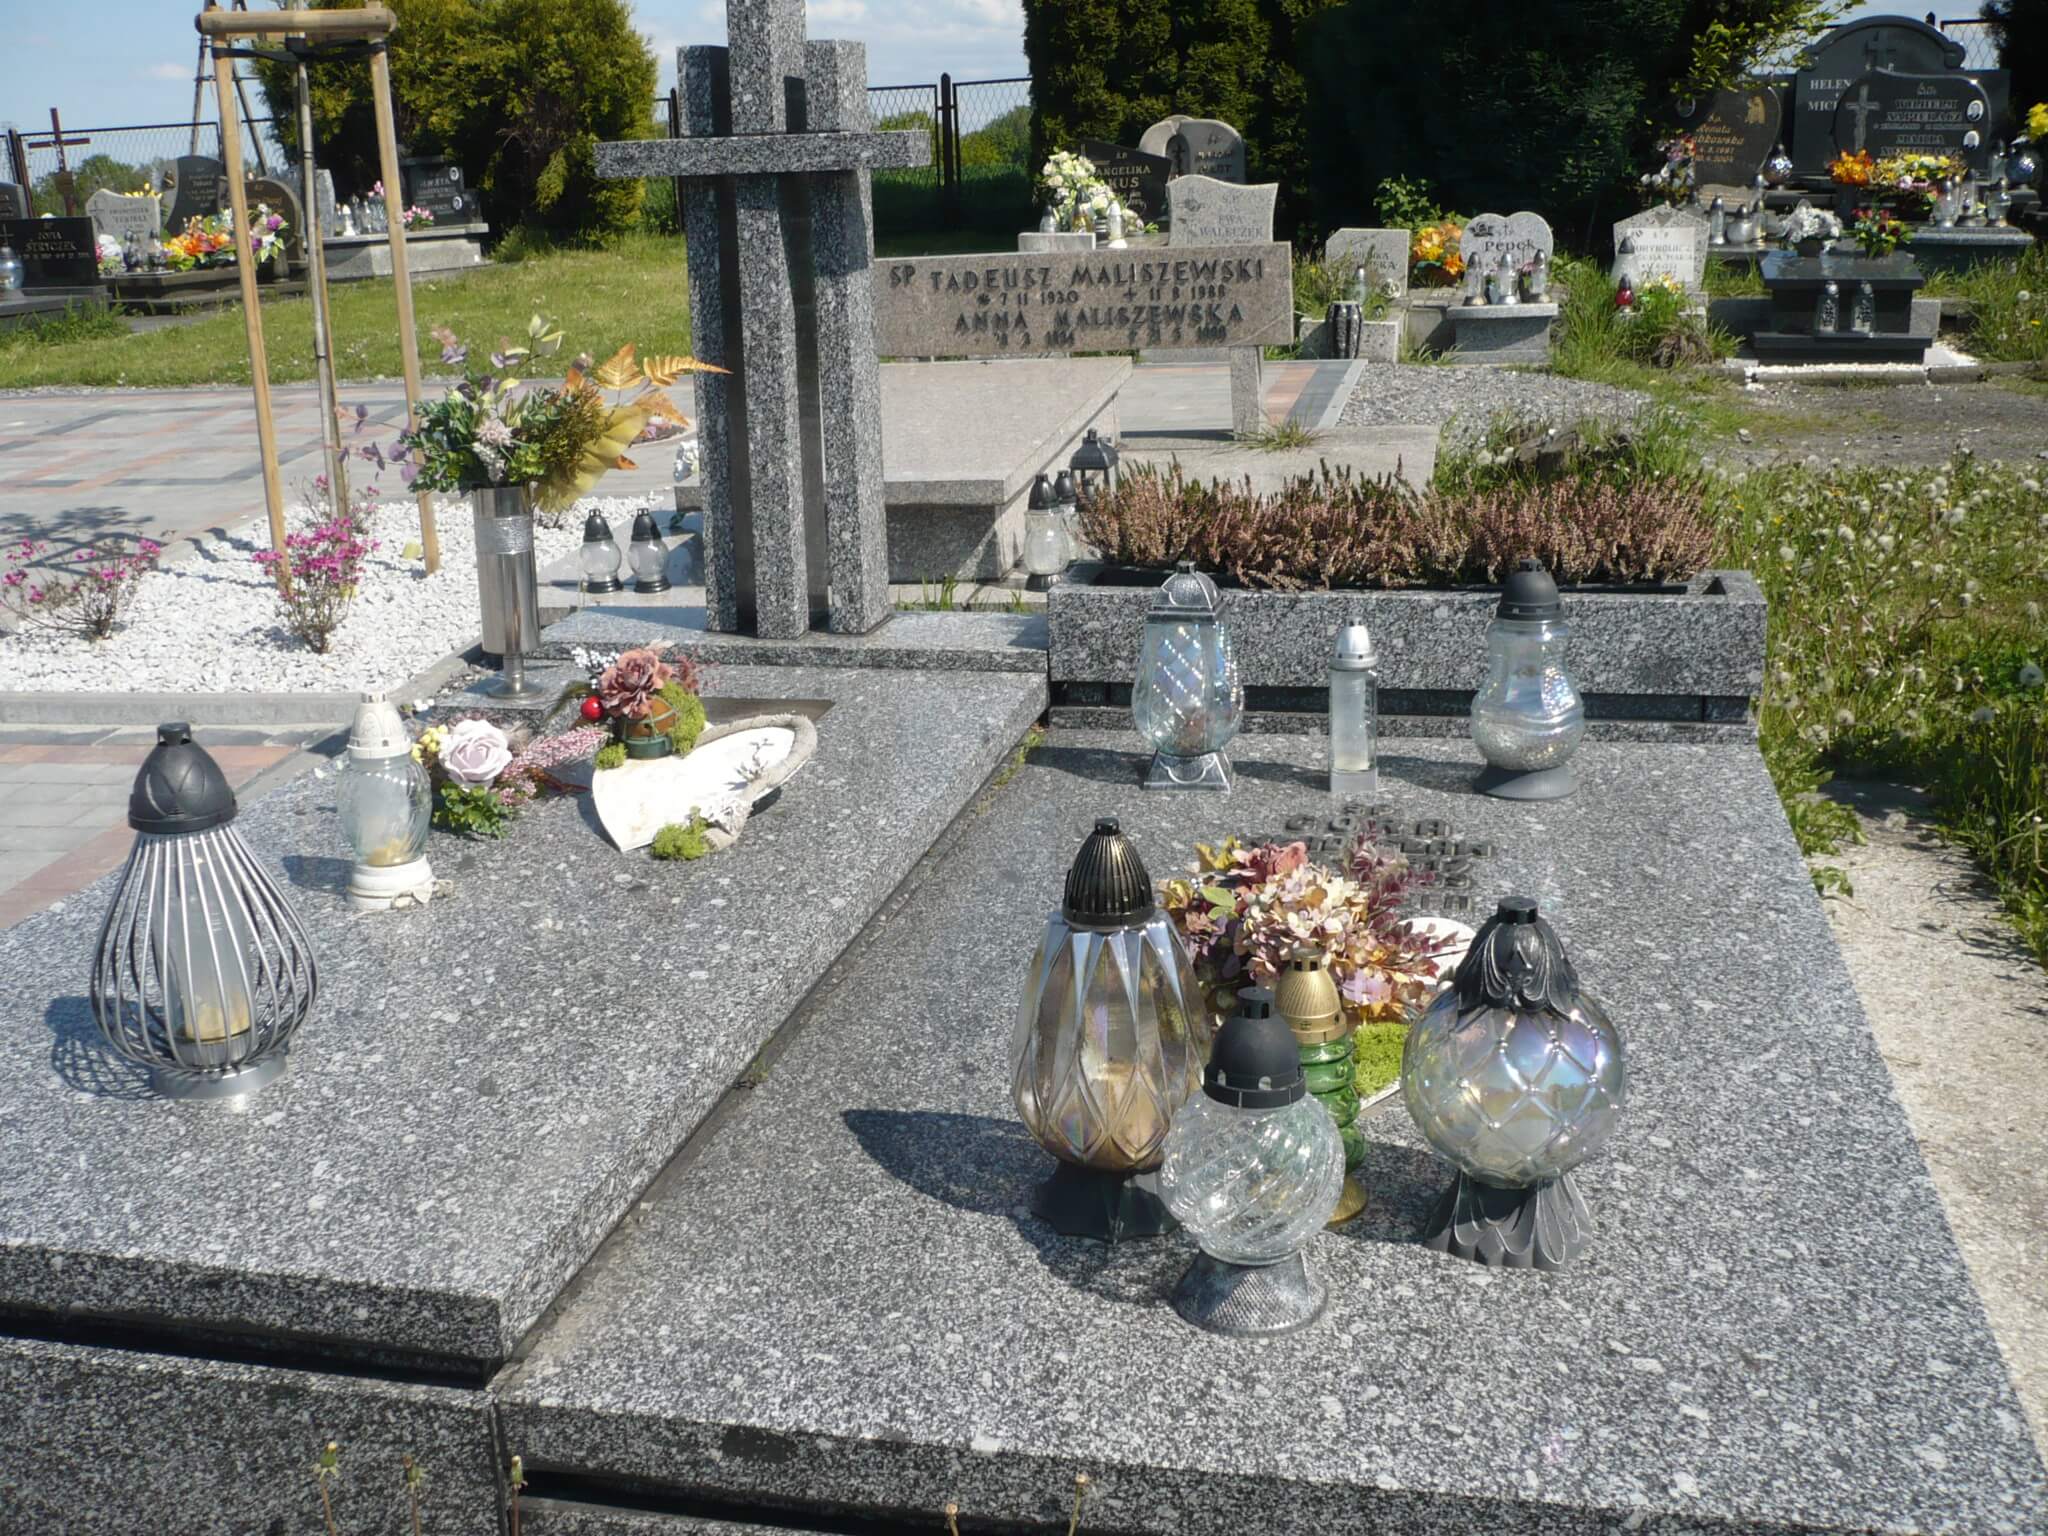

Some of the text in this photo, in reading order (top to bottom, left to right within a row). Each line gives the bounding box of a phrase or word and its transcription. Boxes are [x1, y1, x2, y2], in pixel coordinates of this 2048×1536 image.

[931, 266, 1053, 294] TADEUSZ
[1070, 258, 1264, 286] MALISZEWSKI
[955, 303, 1244, 335] ANNA MALISZEWSKA
